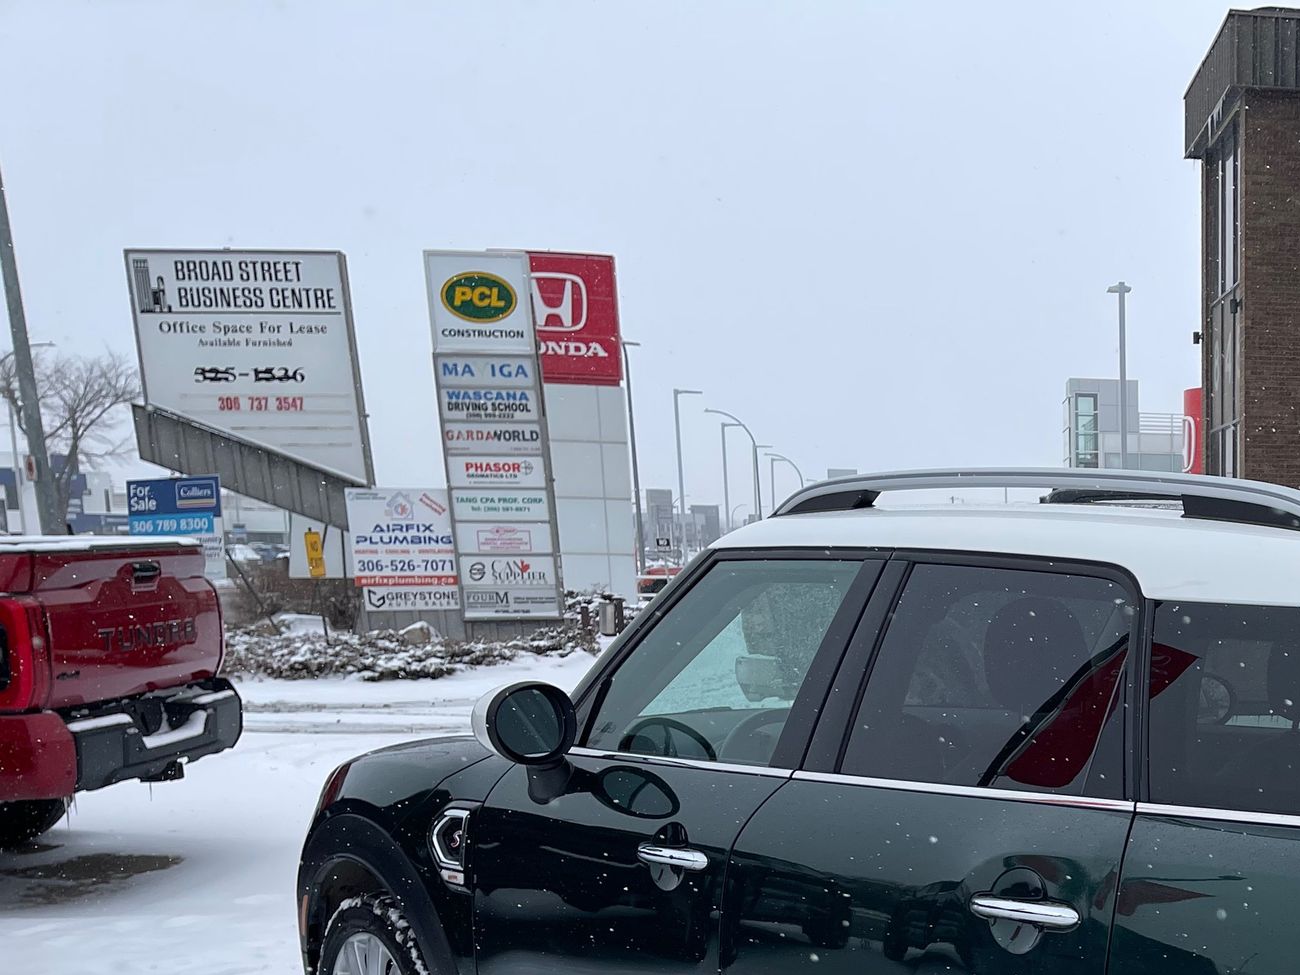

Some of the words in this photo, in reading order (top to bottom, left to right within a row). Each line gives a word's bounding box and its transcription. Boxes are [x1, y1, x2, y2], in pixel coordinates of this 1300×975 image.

[174, 260, 233, 282] BROAD
[240, 260, 302, 282] STREET
[177, 287, 264, 309] BUSINESS
[269, 288, 336, 309] CENTRE
[454, 286, 505, 308] PCL
[159, 321, 206, 334] Office
[212, 321, 252, 336] Space
[260, 321, 282, 334] For
[289, 322, 328, 334] Lease
[441, 329, 524, 339] CONSTRUCTION
[198, 338, 241, 347] Available
[245, 338, 293, 347] Furnished
[538, 341, 608, 357] NDA
[446, 390, 529, 402] WASCANA
[218, 397, 240, 411] 306
[248, 397, 268, 411] 737
[276, 397, 304, 411] 3547
[447, 402, 488, 412] DRIVING
[491, 402, 531, 413] SCHOOL
[465, 462, 521, 473] PHASOR
[130, 484, 150, 497] For
[179, 486, 212, 498] Colliers
[130, 497, 156, 512] Sale
[132, 519, 153, 533] 306
[156, 519, 177, 532] 789
[180, 518, 208, 533] 8300
[372, 523, 435, 533] AIRFIX
[356, 535, 452, 545] PLUMBING
[358, 560, 454, 572] 306-526-7071
[386, 591, 458, 601] GREYSTONE
